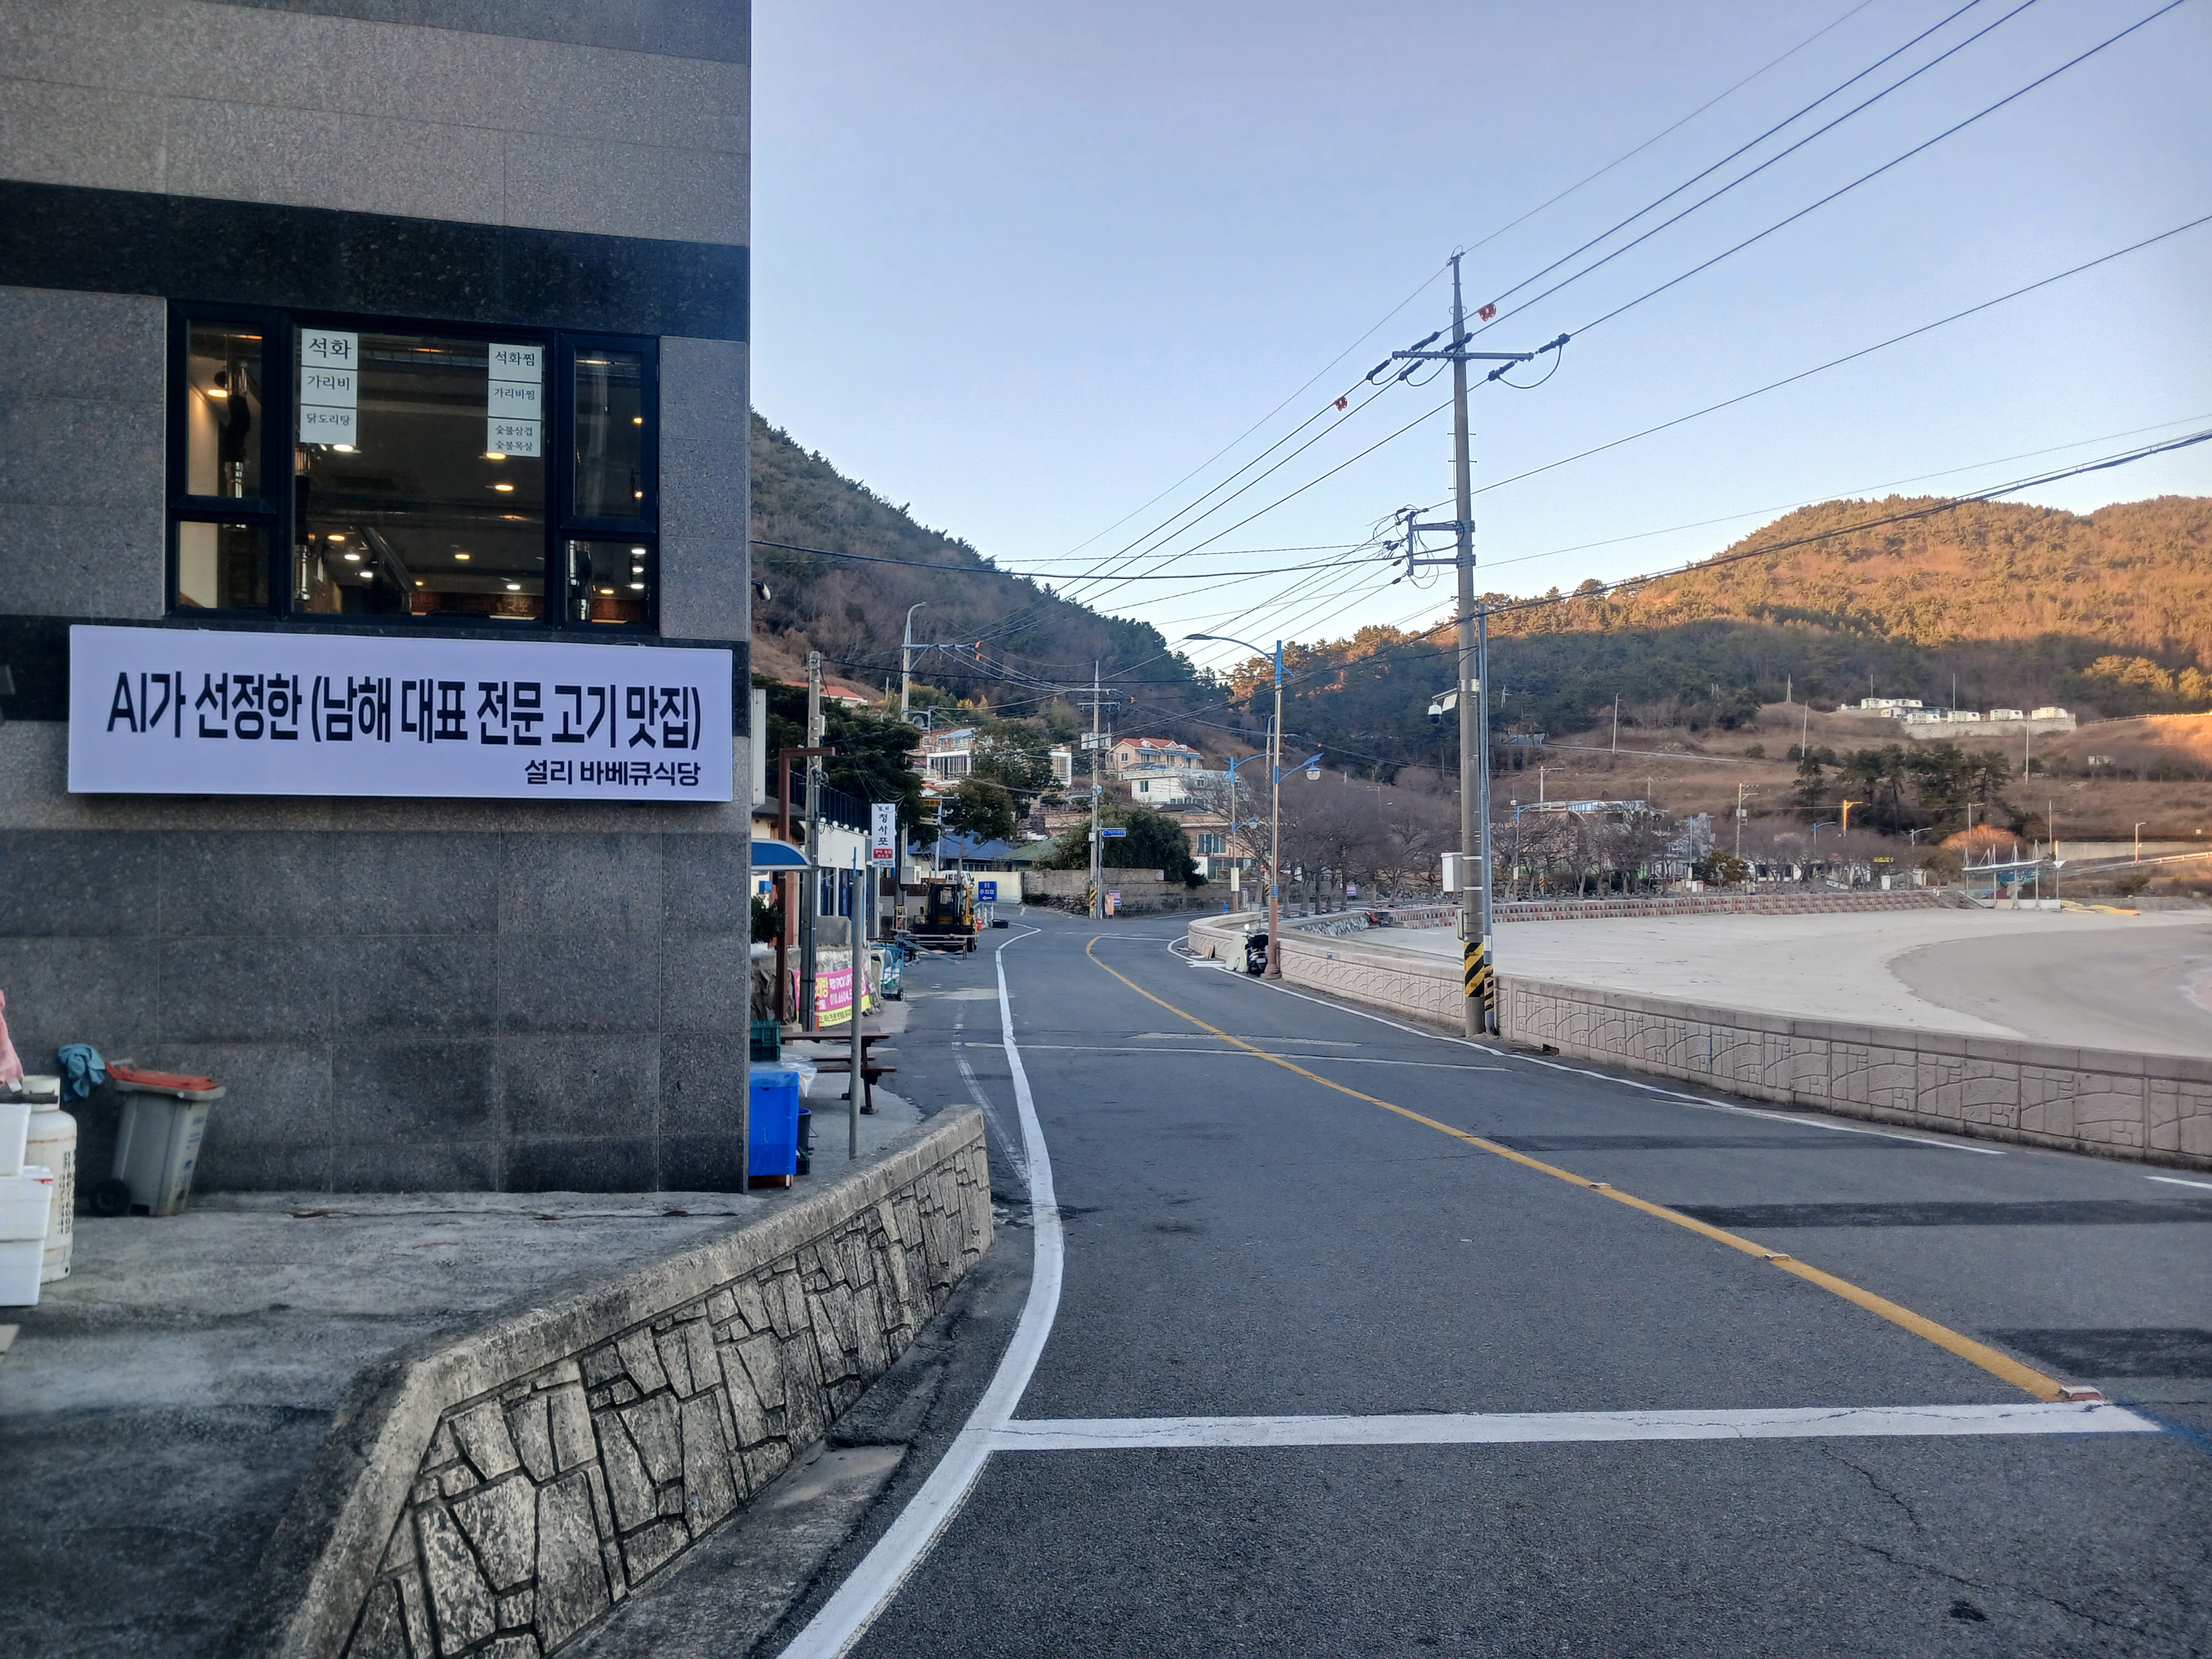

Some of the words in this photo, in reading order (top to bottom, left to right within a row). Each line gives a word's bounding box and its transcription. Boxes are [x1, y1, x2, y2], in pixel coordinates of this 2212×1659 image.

[309, 338, 351, 360] 석화
[495, 351, 535, 366] 석화찜
[307, 375, 350, 391] 가리비
[494, 387, 535, 401] 가리비찜
[307, 413, 350, 426] 닭도리탕
[495, 425, 532, 436] 숯불삼겹
[107, 671, 186, 738] AI가
[195, 673, 302, 741] 선정한
[311, 675, 391, 743] (남해
[401, 678, 468, 744] 대표
[477, 681, 544, 746] 전문
[552, 684, 616, 748] 고기
[626, 685, 701, 751] 맛집)
[524, 760, 573, 785] 설리
[580, 761, 701, 787] 바베큐식당
[878, 813, 889, 846] 청사포
